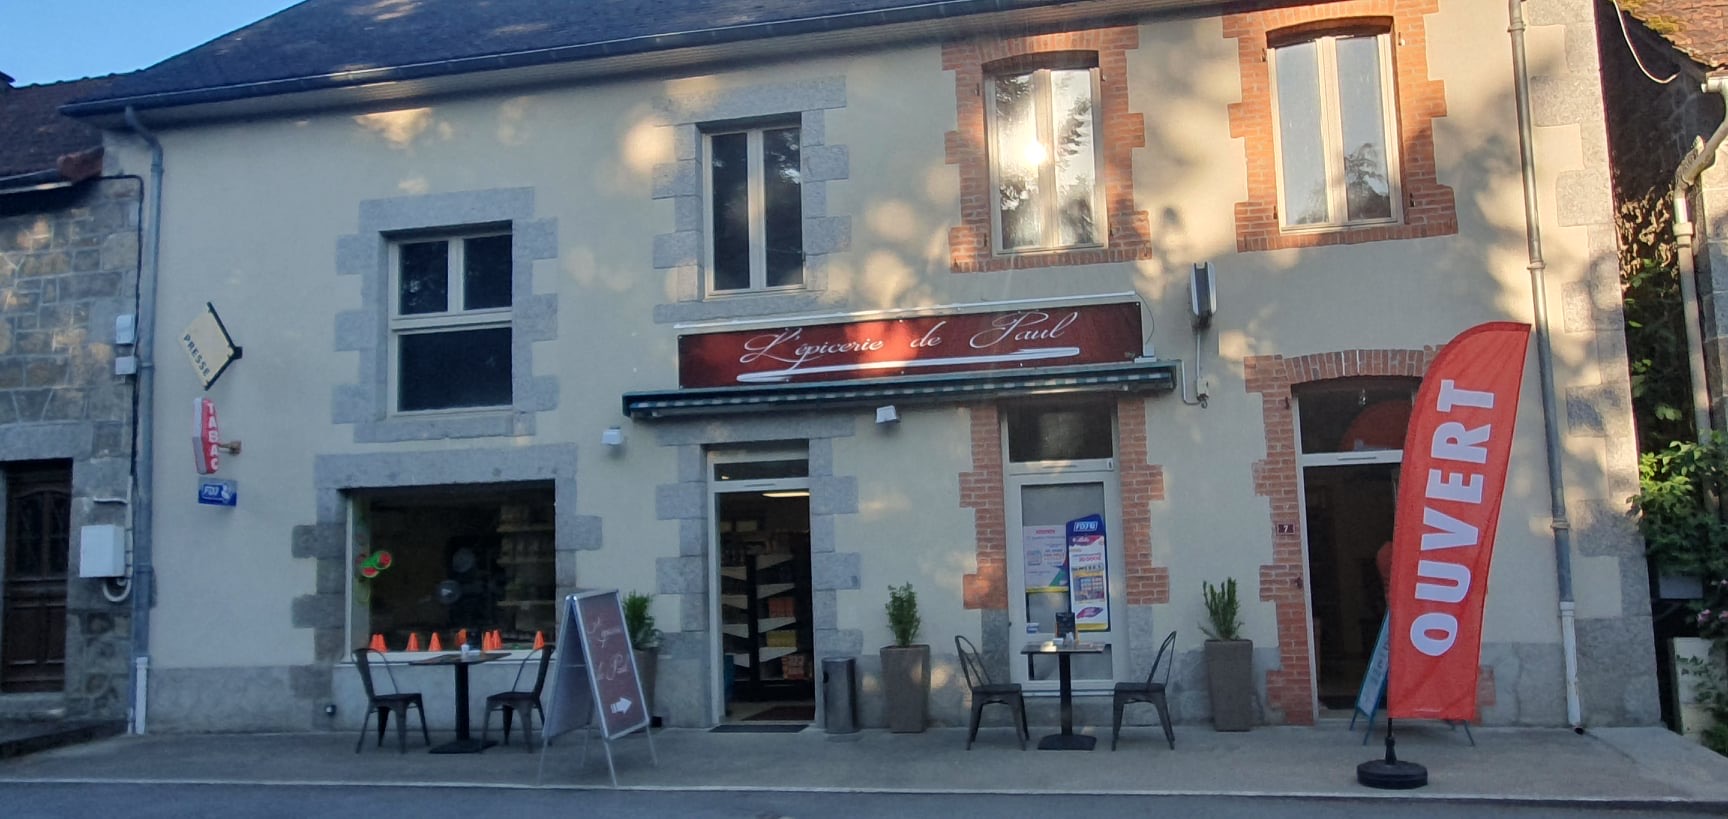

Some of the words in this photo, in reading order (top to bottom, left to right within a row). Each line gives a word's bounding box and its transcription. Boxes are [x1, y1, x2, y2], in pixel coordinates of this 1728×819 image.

[910, 320, 947, 348] de
[969, 311, 1078, 349] Paul
[183, 333, 210, 377] PRESSE
[207, 402, 219, 471] TABAC
[1283, 524, 1289, 533] 7
[1410, 379, 1495, 657] OUVERT
